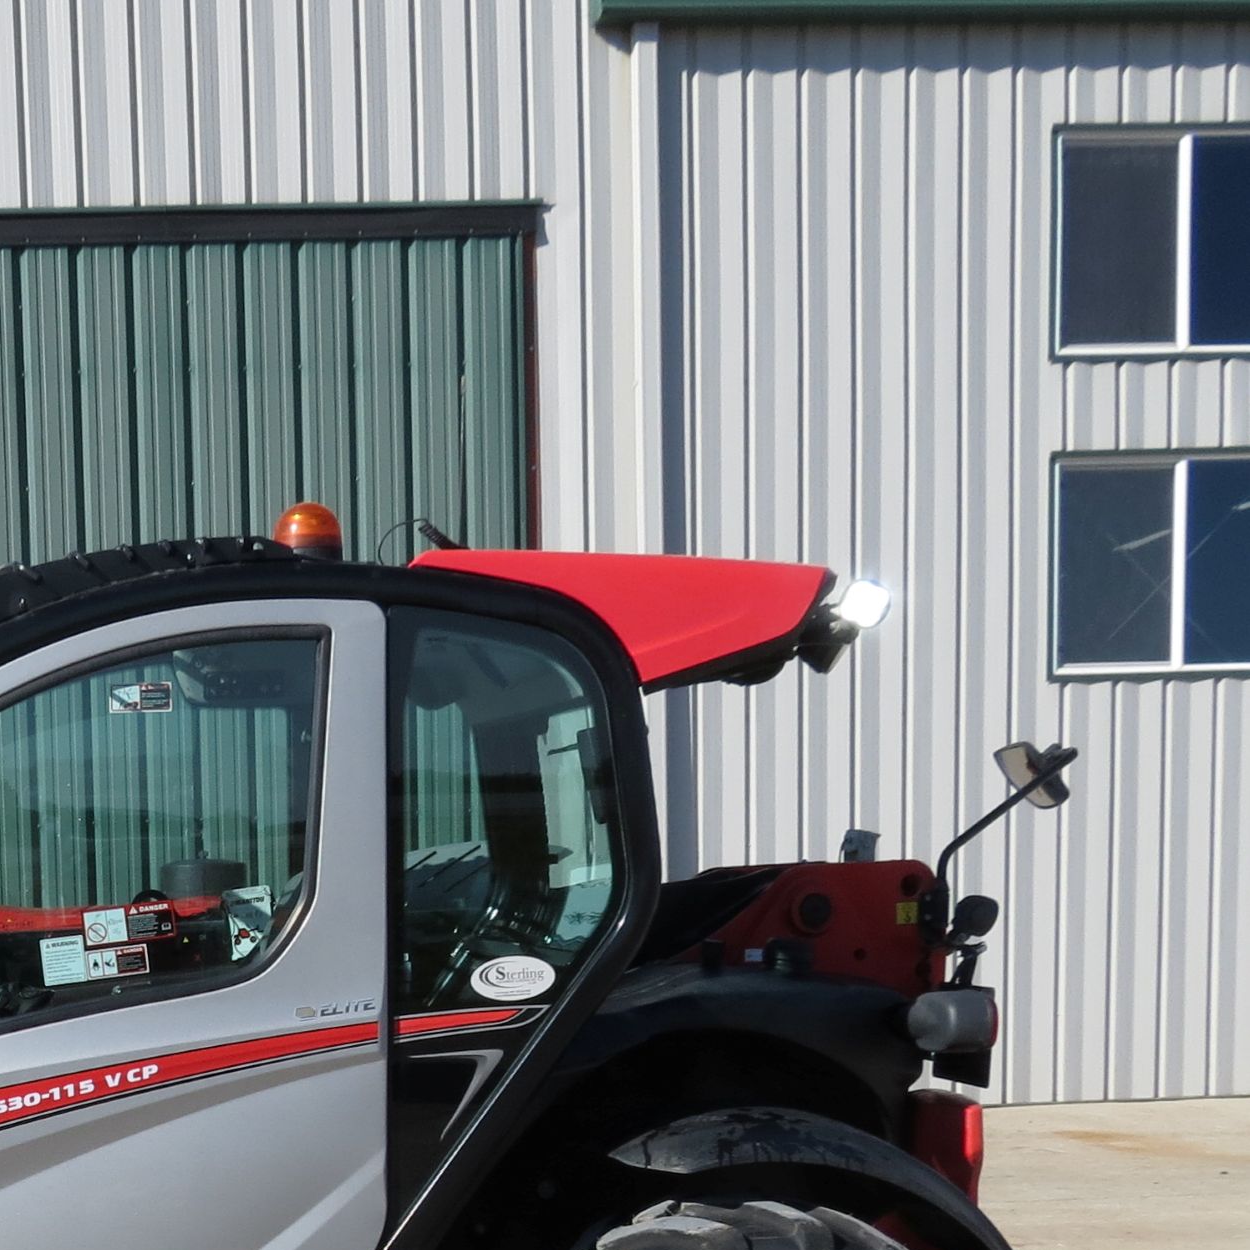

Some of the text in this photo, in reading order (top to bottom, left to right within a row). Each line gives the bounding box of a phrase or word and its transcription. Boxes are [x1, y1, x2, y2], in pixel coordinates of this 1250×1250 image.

[138, 903, 169, 913] DANGER
[495, 966, 545, 980] Sterling
[320, 999, 376, 1017] ELITE
